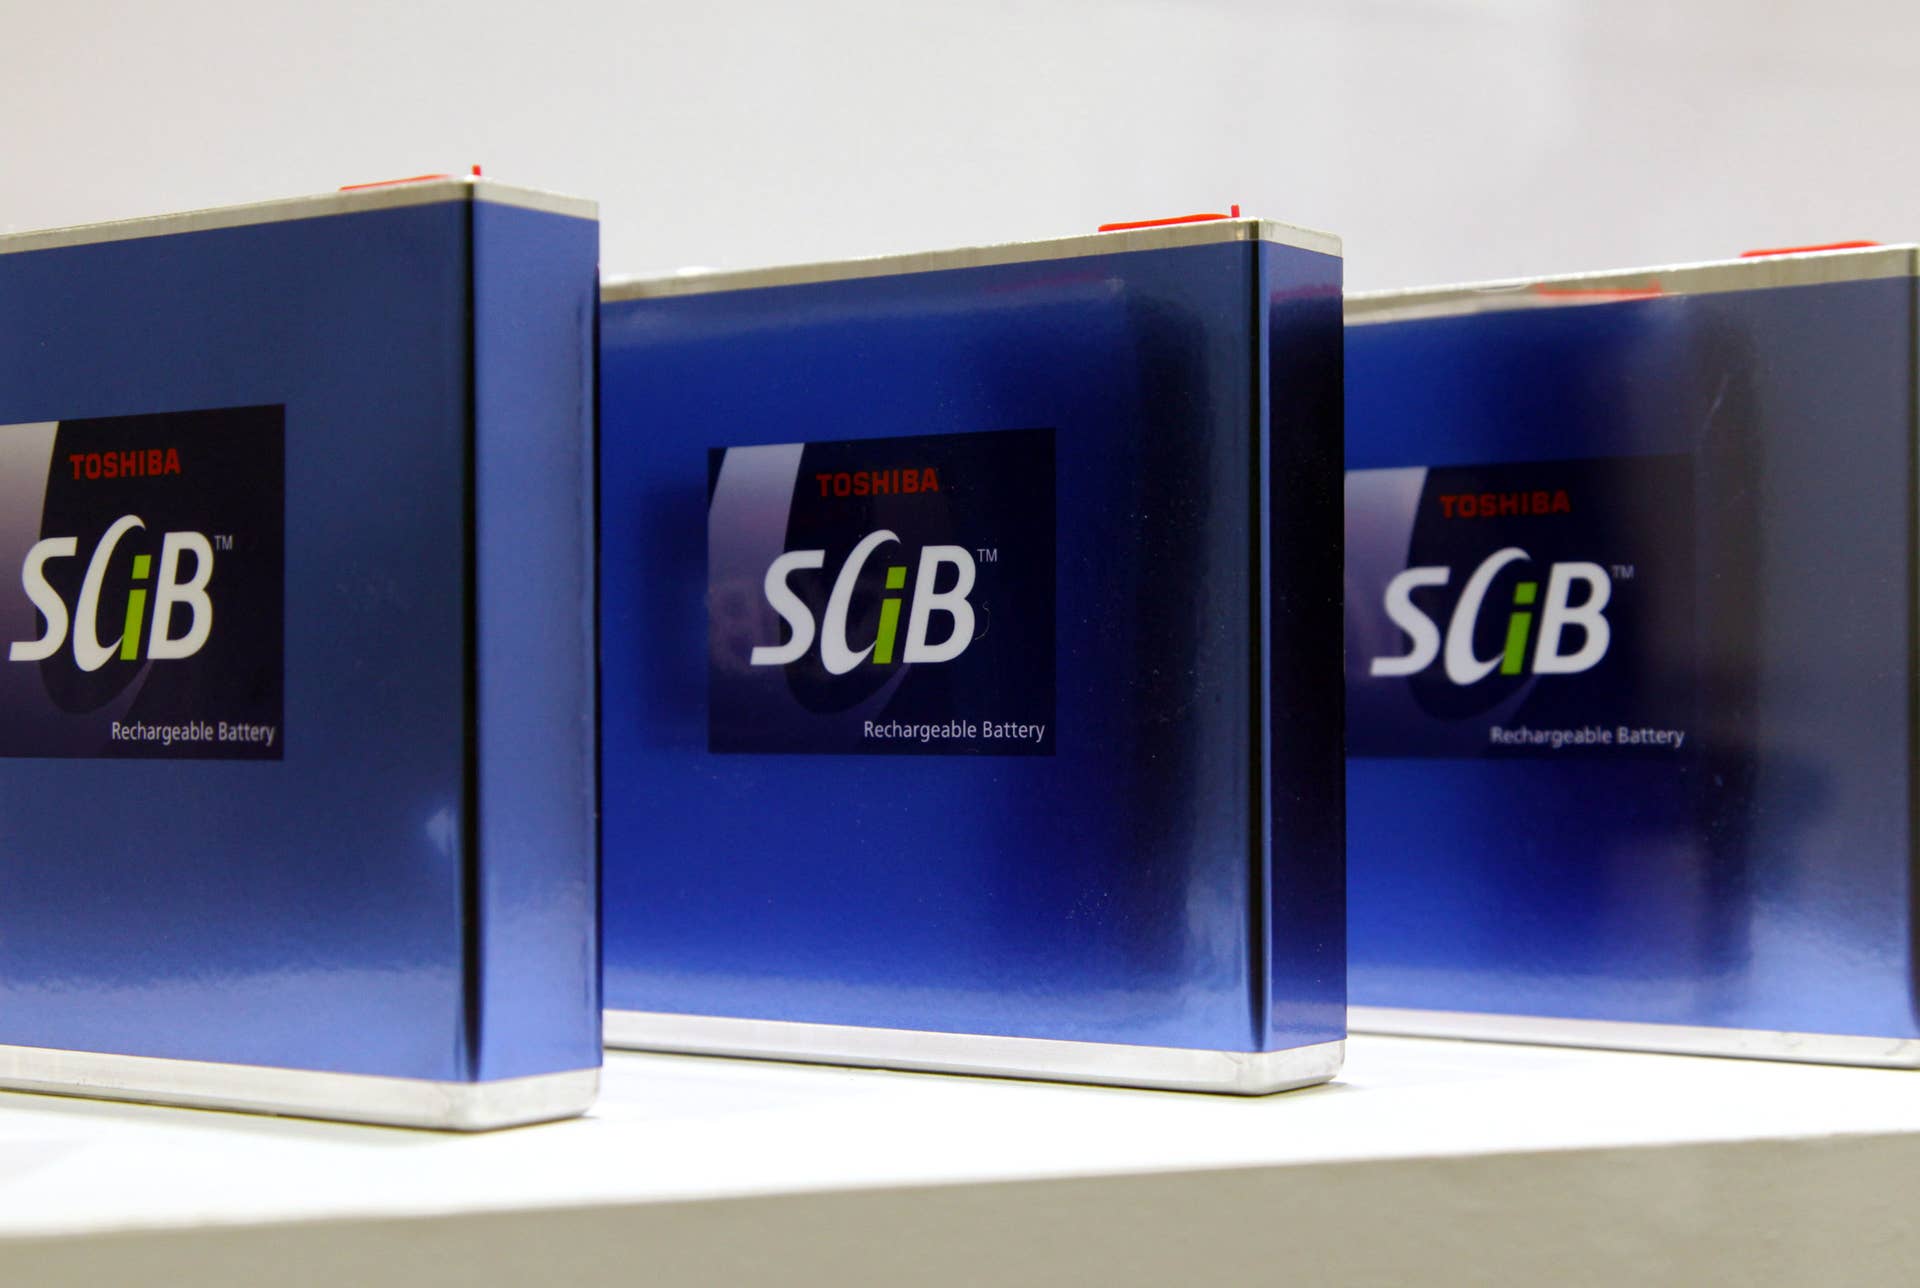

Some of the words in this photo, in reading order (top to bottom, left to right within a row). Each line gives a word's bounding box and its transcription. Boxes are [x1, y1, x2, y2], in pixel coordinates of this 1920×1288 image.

[69, 447, 181, 480] TOSHIBA
[816, 467, 940, 497] TOSHIBA
[1440, 490, 1571, 519] TOSHIBA
[111, 721, 213, 746] Rechargeable
[218, 722, 275, 747] Battery
[864, 720, 977, 742] Rechargeable
[983, 720, 1045, 743] Battery
[1490, 726, 1613, 747] Rechargeable
[1618, 726, 1685, 749] Battery
